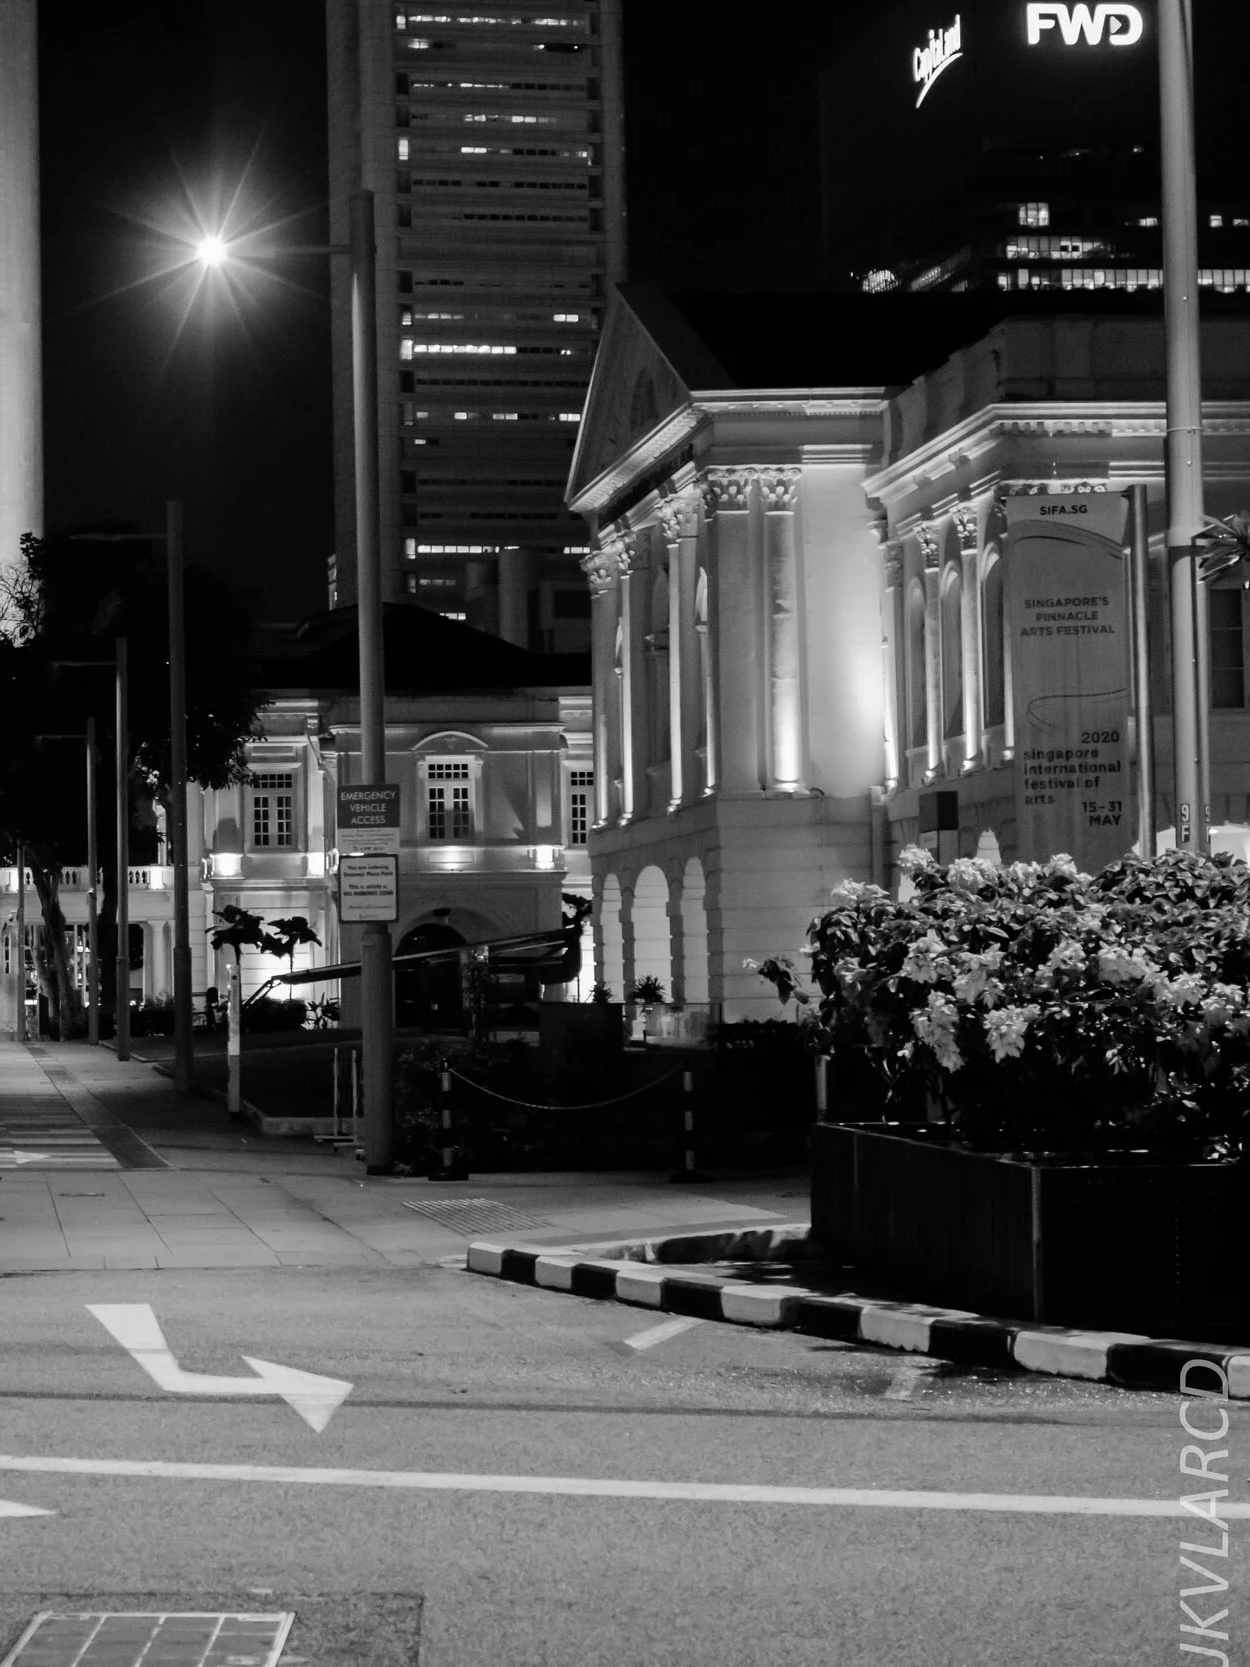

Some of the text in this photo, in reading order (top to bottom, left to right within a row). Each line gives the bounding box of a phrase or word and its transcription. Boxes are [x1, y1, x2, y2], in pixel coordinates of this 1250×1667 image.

[1027, 3, 1143, 46] FWD
[1040, 504, 1088, 515] SIFA.SG
[1025, 596, 1110, 609] SINGAPORE'S
[1036, 611, 1098, 622] PINNACLE
[1020, 624, 1116, 637] ARTS FESTIVAL
[1081, 730, 1120, 744] 2020
[1023, 748, 1099, 762] singapore
[1023, 760, 1121, 775] international
[1024, 776, 1100, 790] festival of
[341, 790, 395, 801] EMERGENCY
[1024, 794, 1055, 805] arts
[350, 803, 387, 813] VEHICLE
[350, 815, 386, 825] ACCESS
[1089, 815, 1121, 826] MAY
